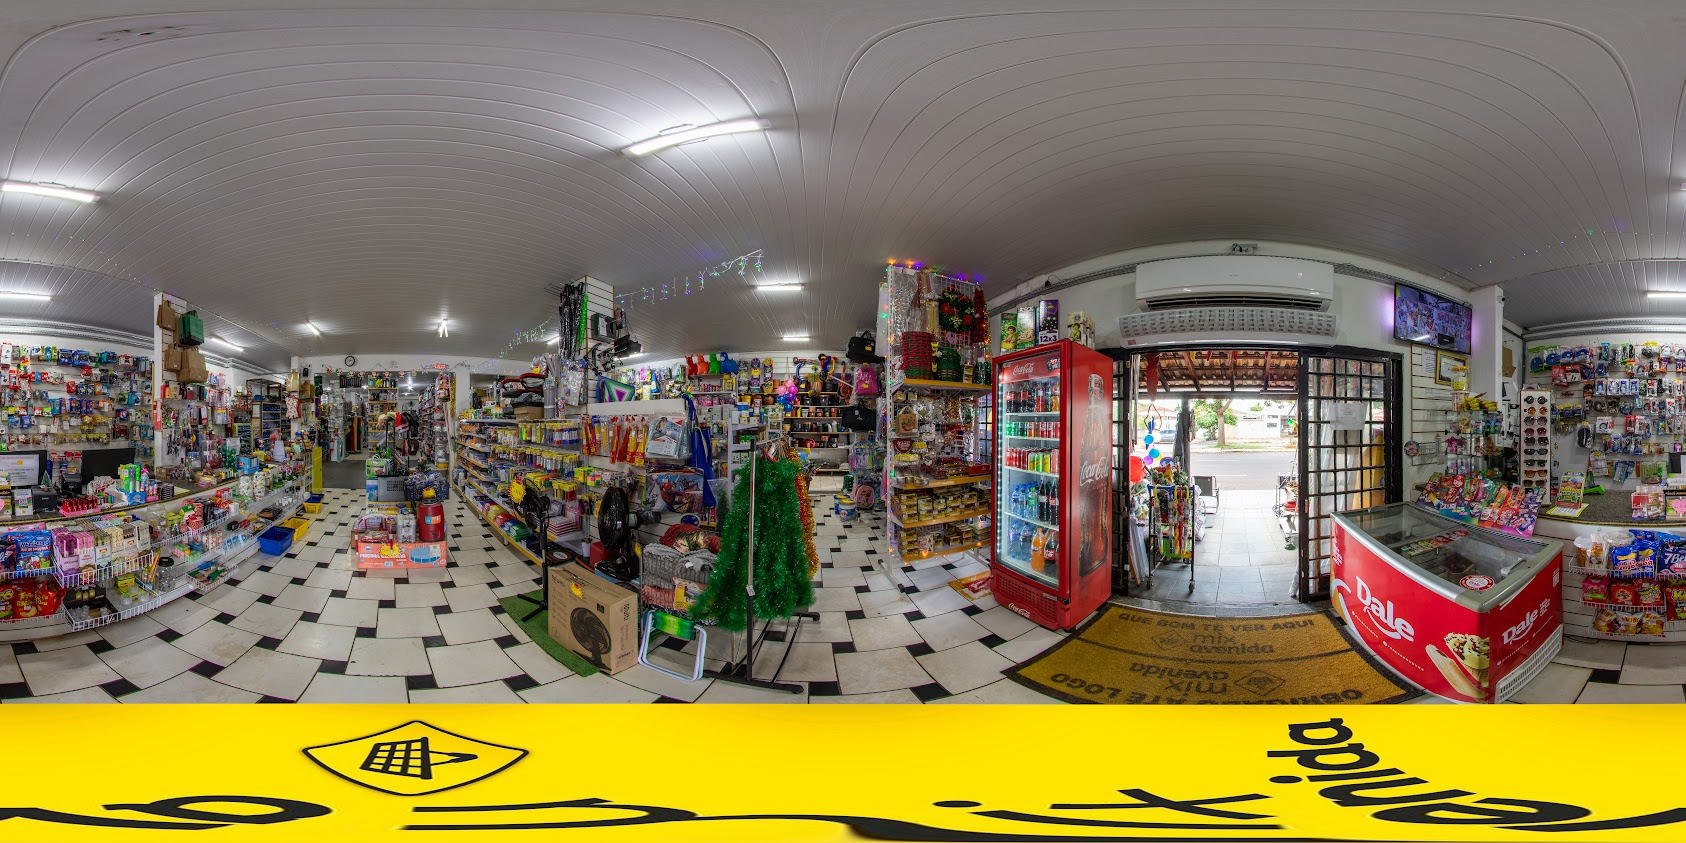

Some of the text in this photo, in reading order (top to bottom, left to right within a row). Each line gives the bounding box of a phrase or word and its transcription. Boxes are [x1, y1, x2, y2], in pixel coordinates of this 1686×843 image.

[1040, 335, 1057, 343] 12x3
[1356, 576, 1415, 642] Dale
[1118, 613, 1315, 632] QUE BOM TE VER AQUI
[1502, 609, 1538, 645] Dale
[1192, 631, 1236, 644] mix
[1189, 643, 1276, 654] avenida
[1129, 662, 1229, 680] avenida
[1050, 673, 1122, 699] LOGO
[1165, 679, 1228, 696] mix
